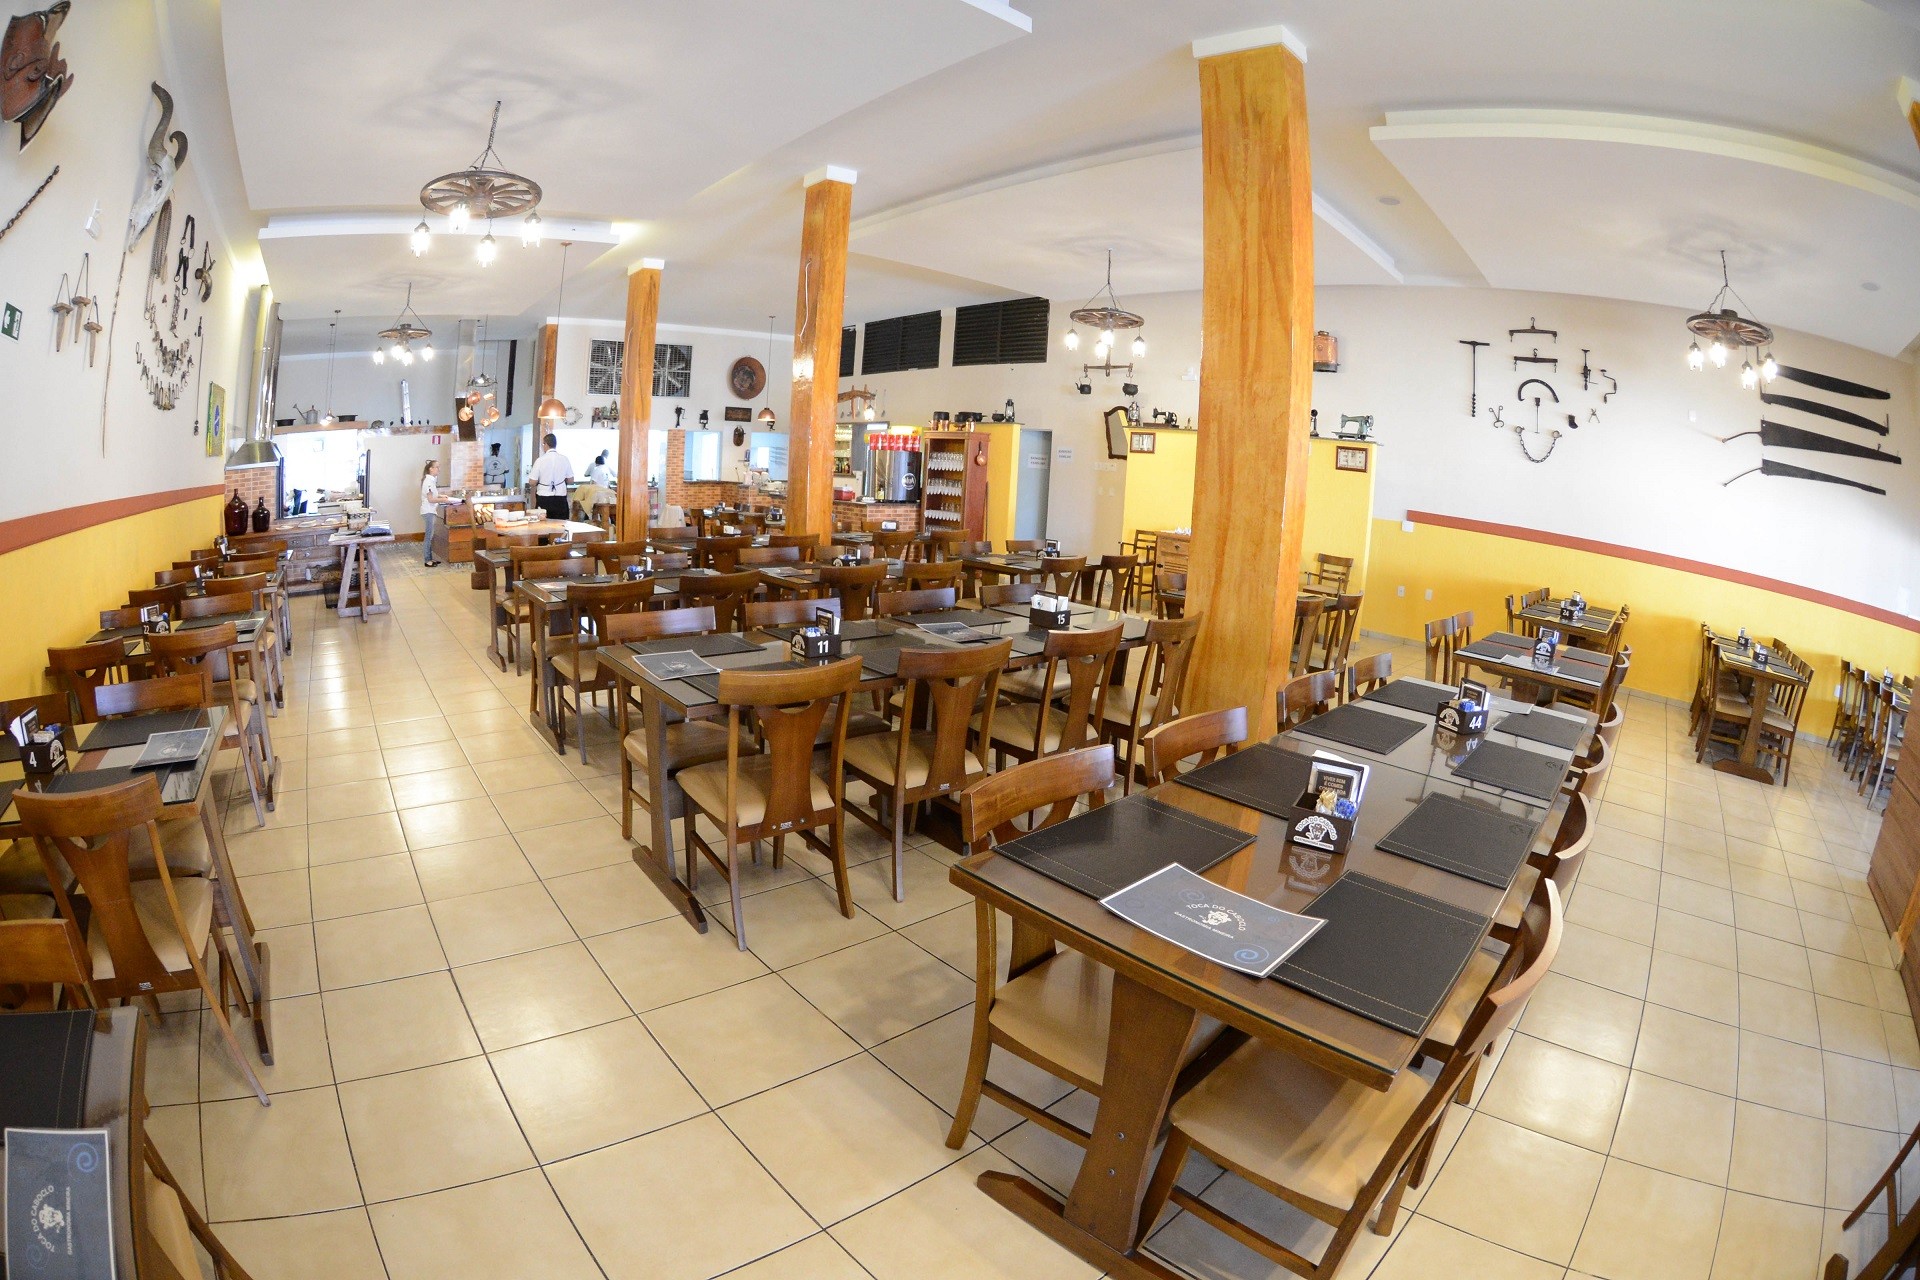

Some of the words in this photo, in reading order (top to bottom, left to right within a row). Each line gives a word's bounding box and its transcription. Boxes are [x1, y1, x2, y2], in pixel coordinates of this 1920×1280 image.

[1057, 613, 1066, 625] 15
[1562, 609, 1569, 617] 24
[817, 640, 829, 654] 11
[1758, 654, 1765, 662] 25
[1469, 715, 1483, 730] 44
[29, 751, 37, 768] 4
[1297, 818, 1310, 831] TOCA
[1318, 817, 1337, 839] CABOCLO
[1226, 909, 1247, 931] CABOCLO
[30, 1184, 55, 1217] CABOCLO
[31, 1218, 40, 1232] DO
[37, 1232, 55, 1253] TOCA
